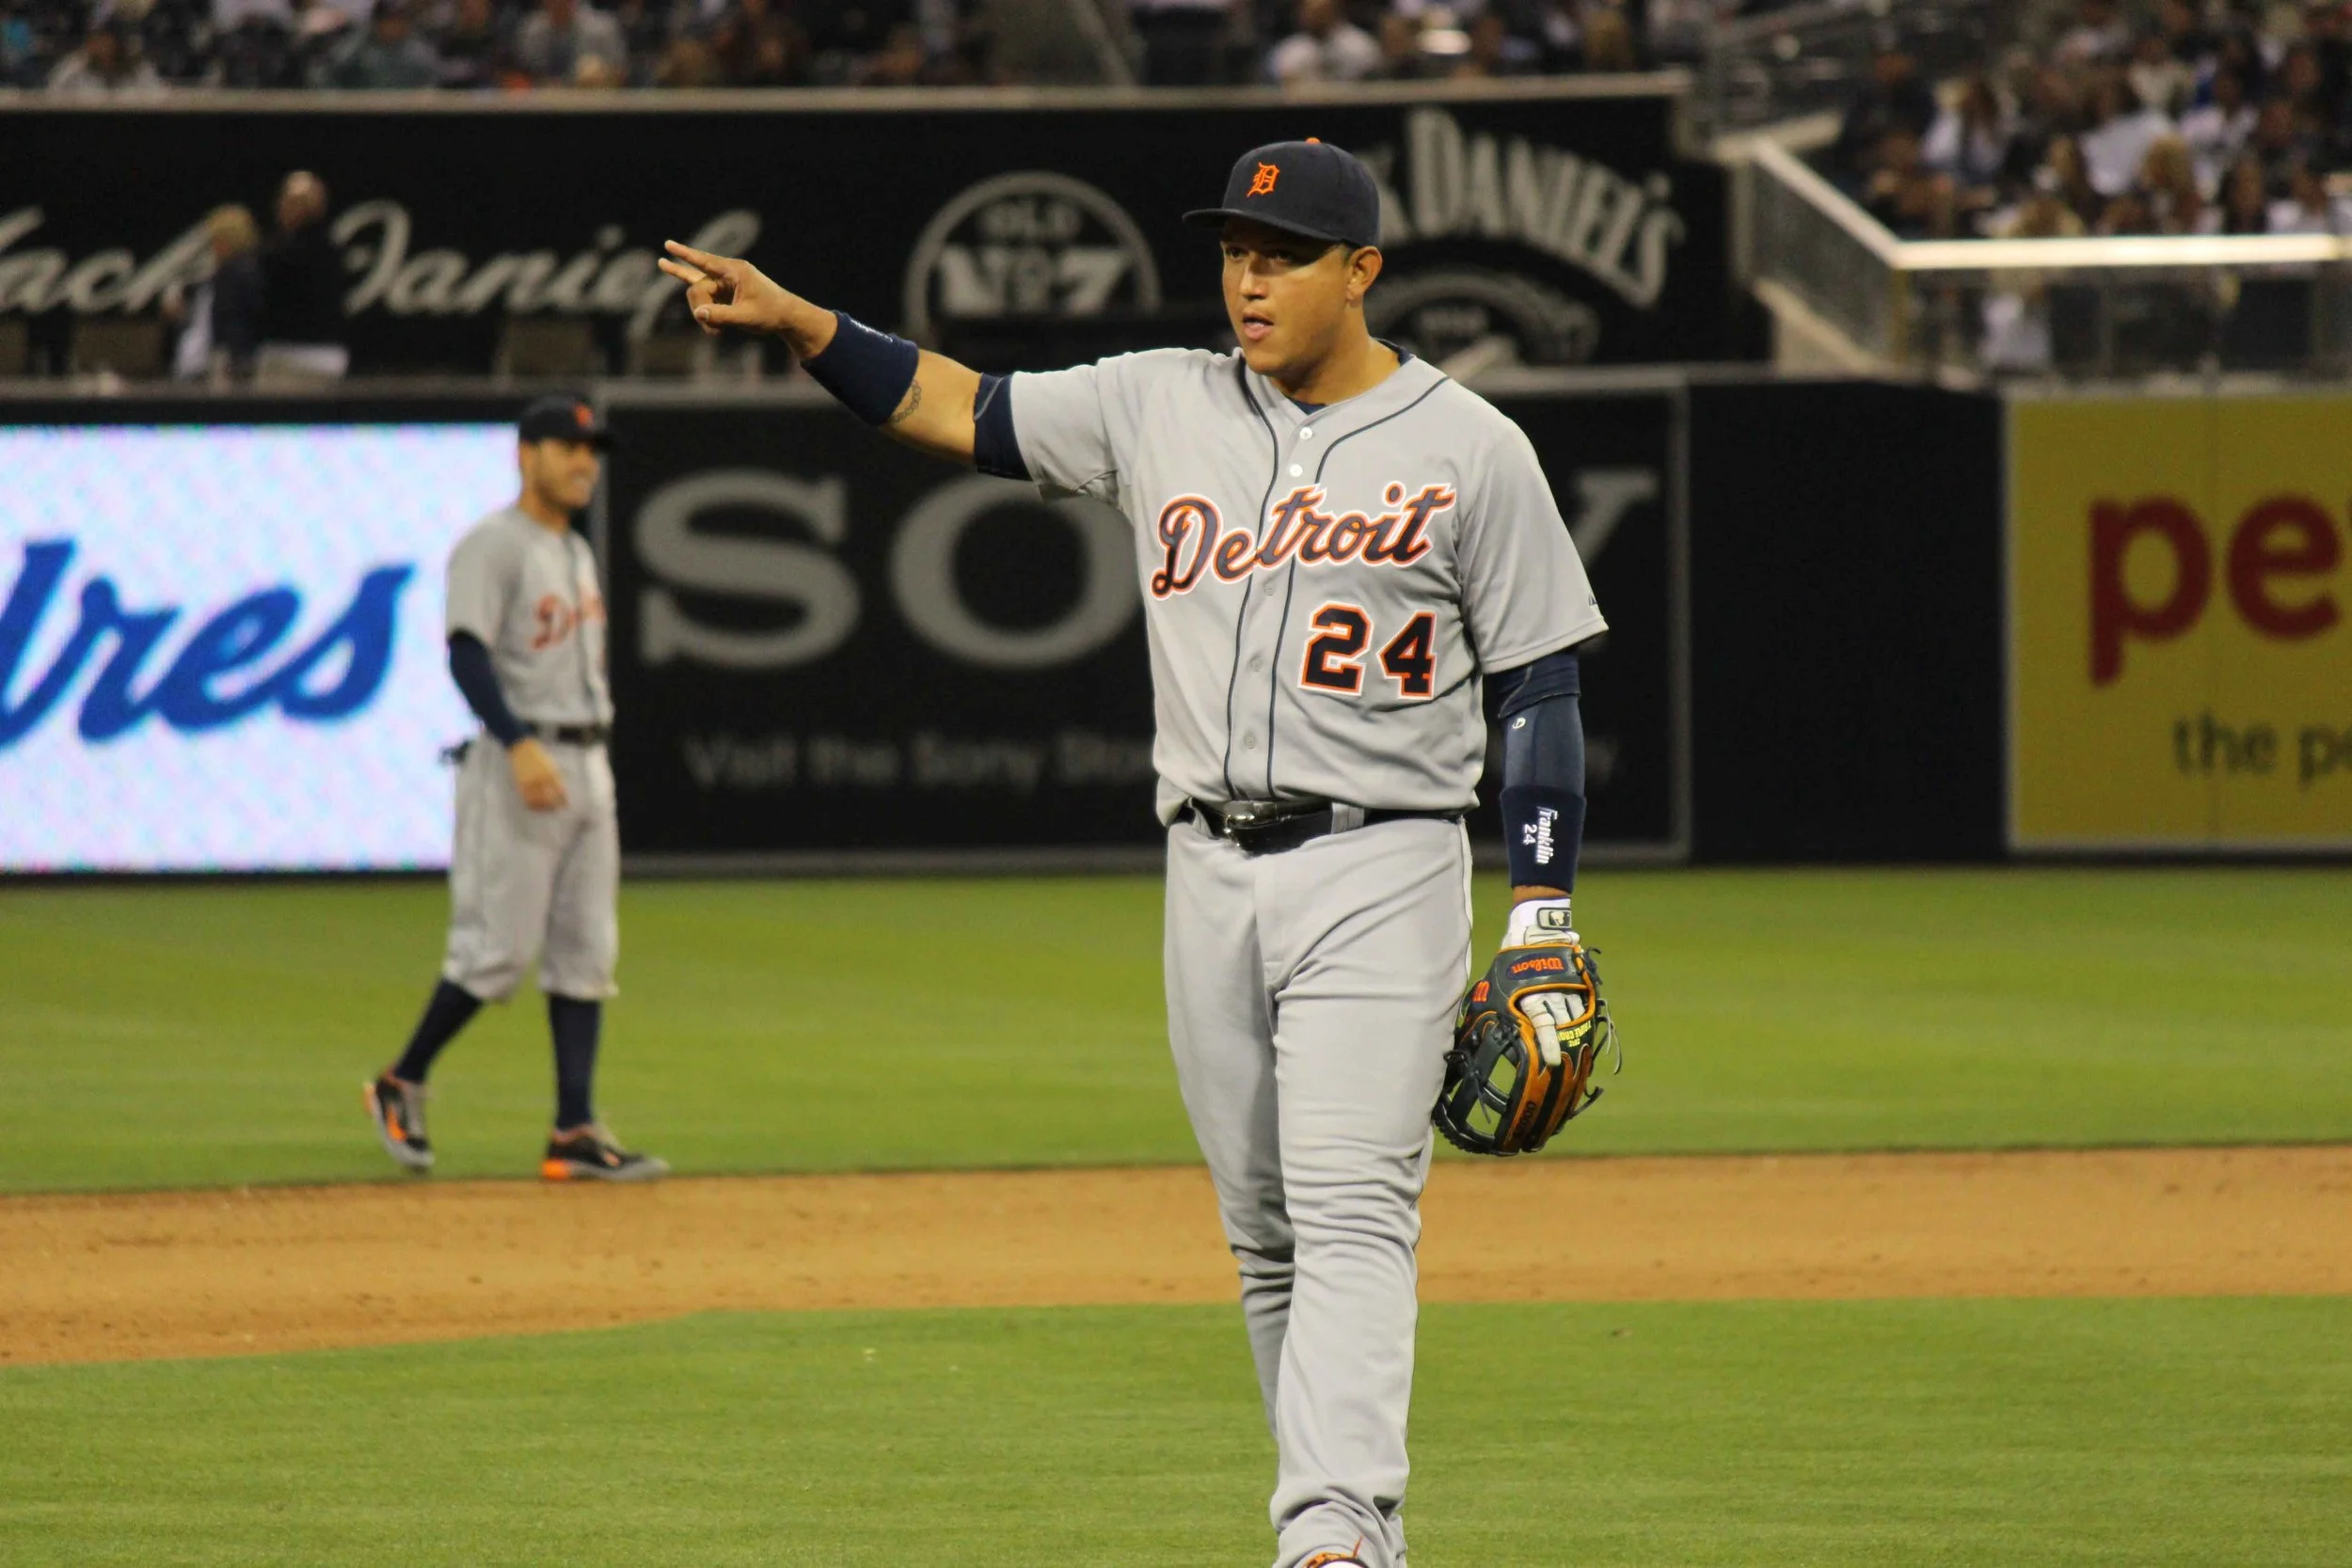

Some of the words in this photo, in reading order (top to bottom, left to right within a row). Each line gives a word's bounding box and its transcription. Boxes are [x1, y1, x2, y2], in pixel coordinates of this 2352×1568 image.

[1246, 162, 1280, 198] D
[0, 205, 216, 313] ack
[1151, 481, 1456, 600] Detroit
[2088, 494, 2352, 689] pe
[1297, 600, 1437, 700] 24
[2172, 712, 2278, 777] the
[1522, 823, 1538, 846] 24
[1535, 805, 1561, 864] Franklin
[1510, 957, 1565, 975] Wilson
